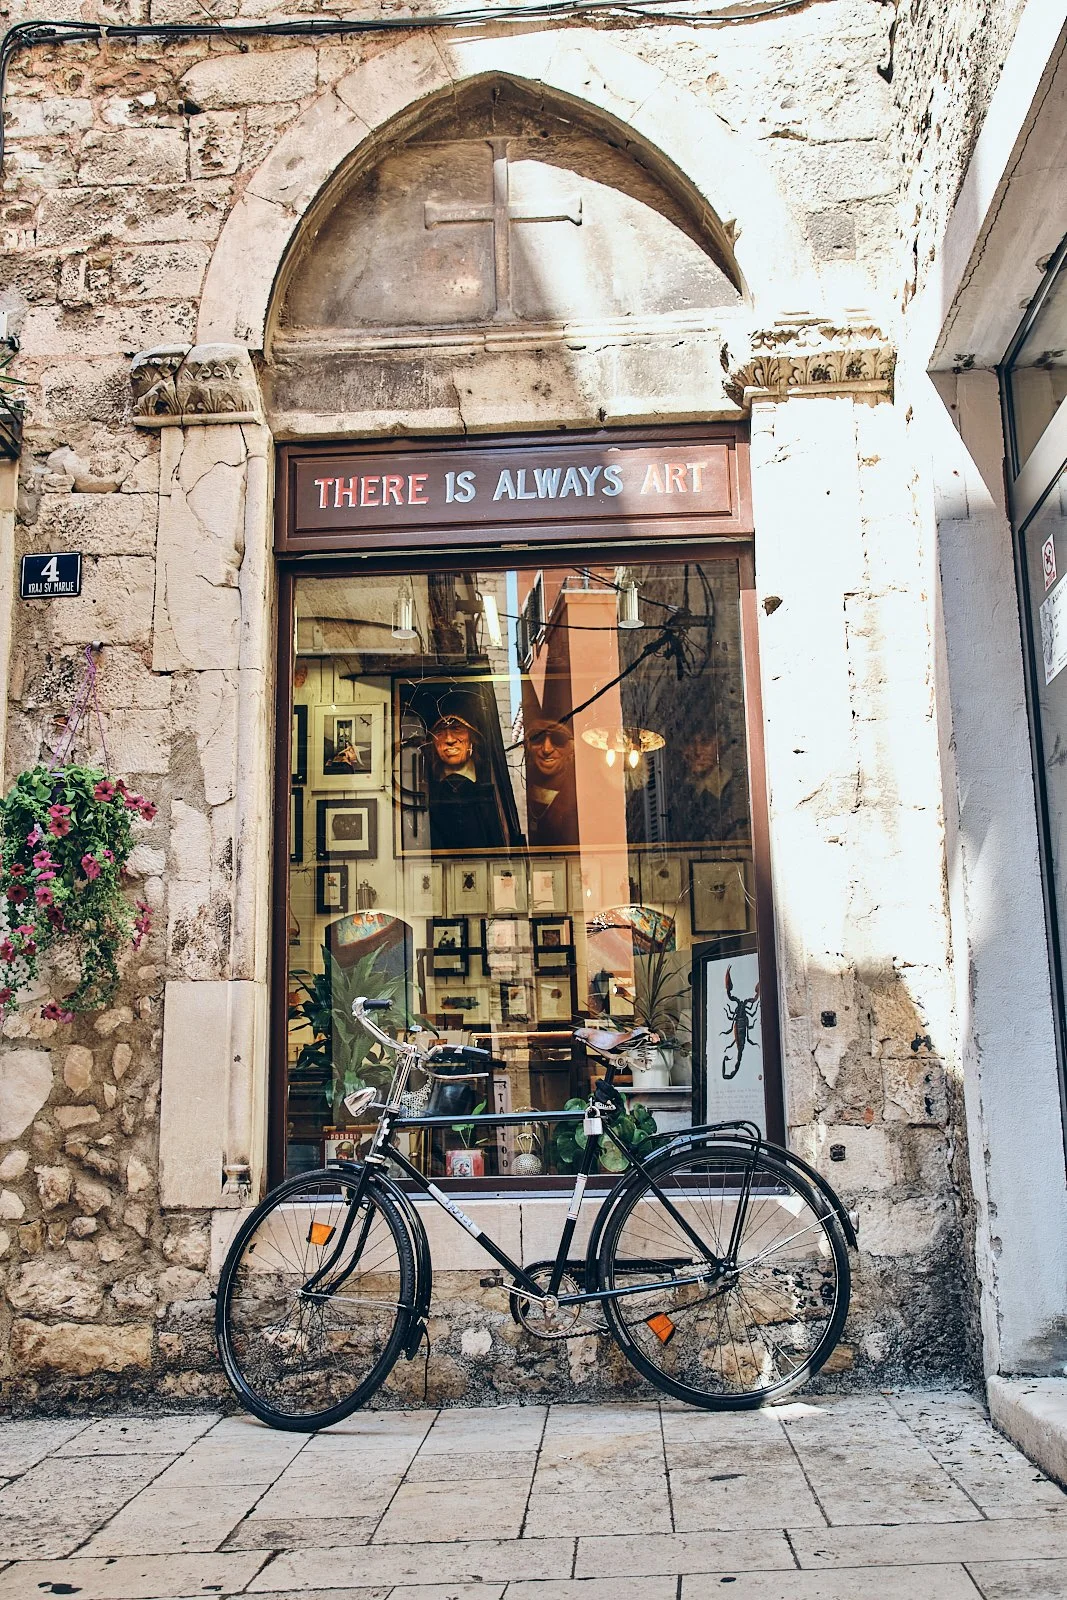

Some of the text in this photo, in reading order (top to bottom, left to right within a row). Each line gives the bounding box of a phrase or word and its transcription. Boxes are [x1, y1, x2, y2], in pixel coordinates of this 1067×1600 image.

[314, 461, 709, 508] THERE IS ALWAYS ART
[28, 581, 74, 593] KRAJ SV. MARIJE
[41, 557, 59, 582] 4
[498, 1092, 509, 1168] TATOO
